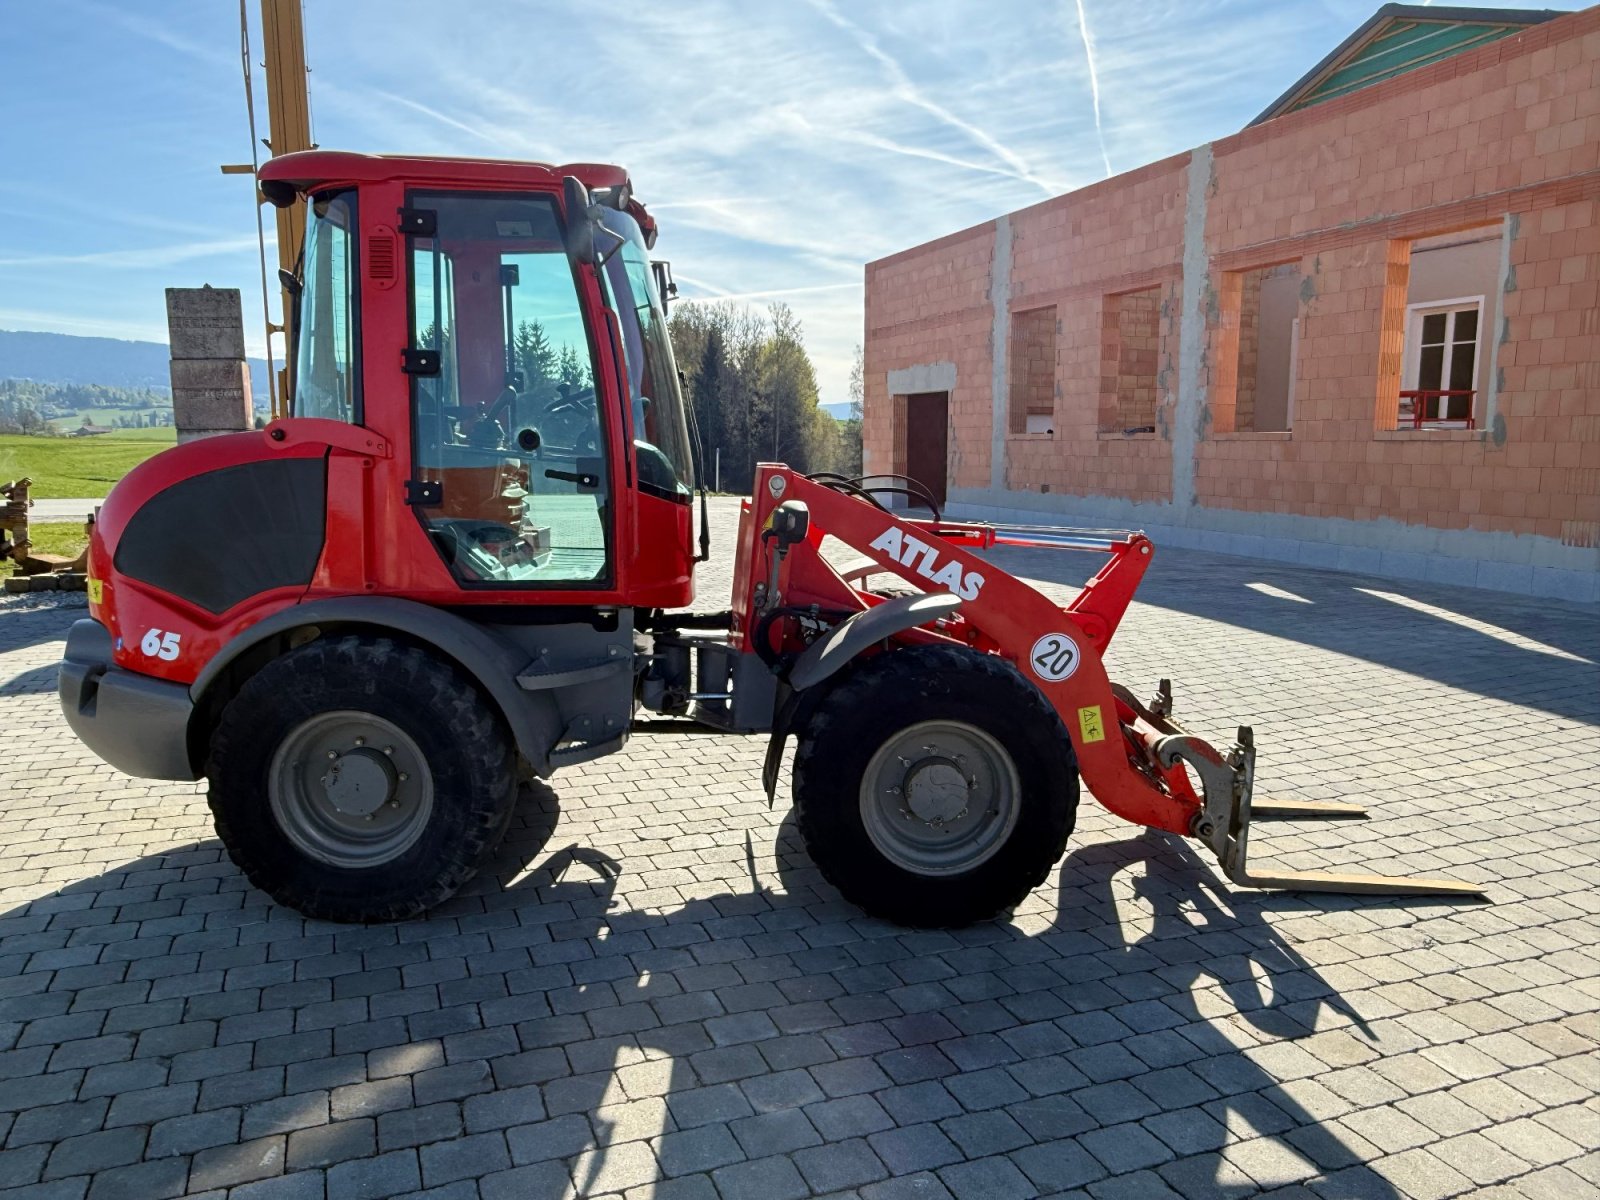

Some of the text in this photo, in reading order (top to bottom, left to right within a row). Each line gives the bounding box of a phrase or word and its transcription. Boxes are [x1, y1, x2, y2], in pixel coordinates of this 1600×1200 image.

[869, 526, 985, 600] ATLAS
[141, 628, 181, 661] 65
[1034, 639, 1073, 675] 20
